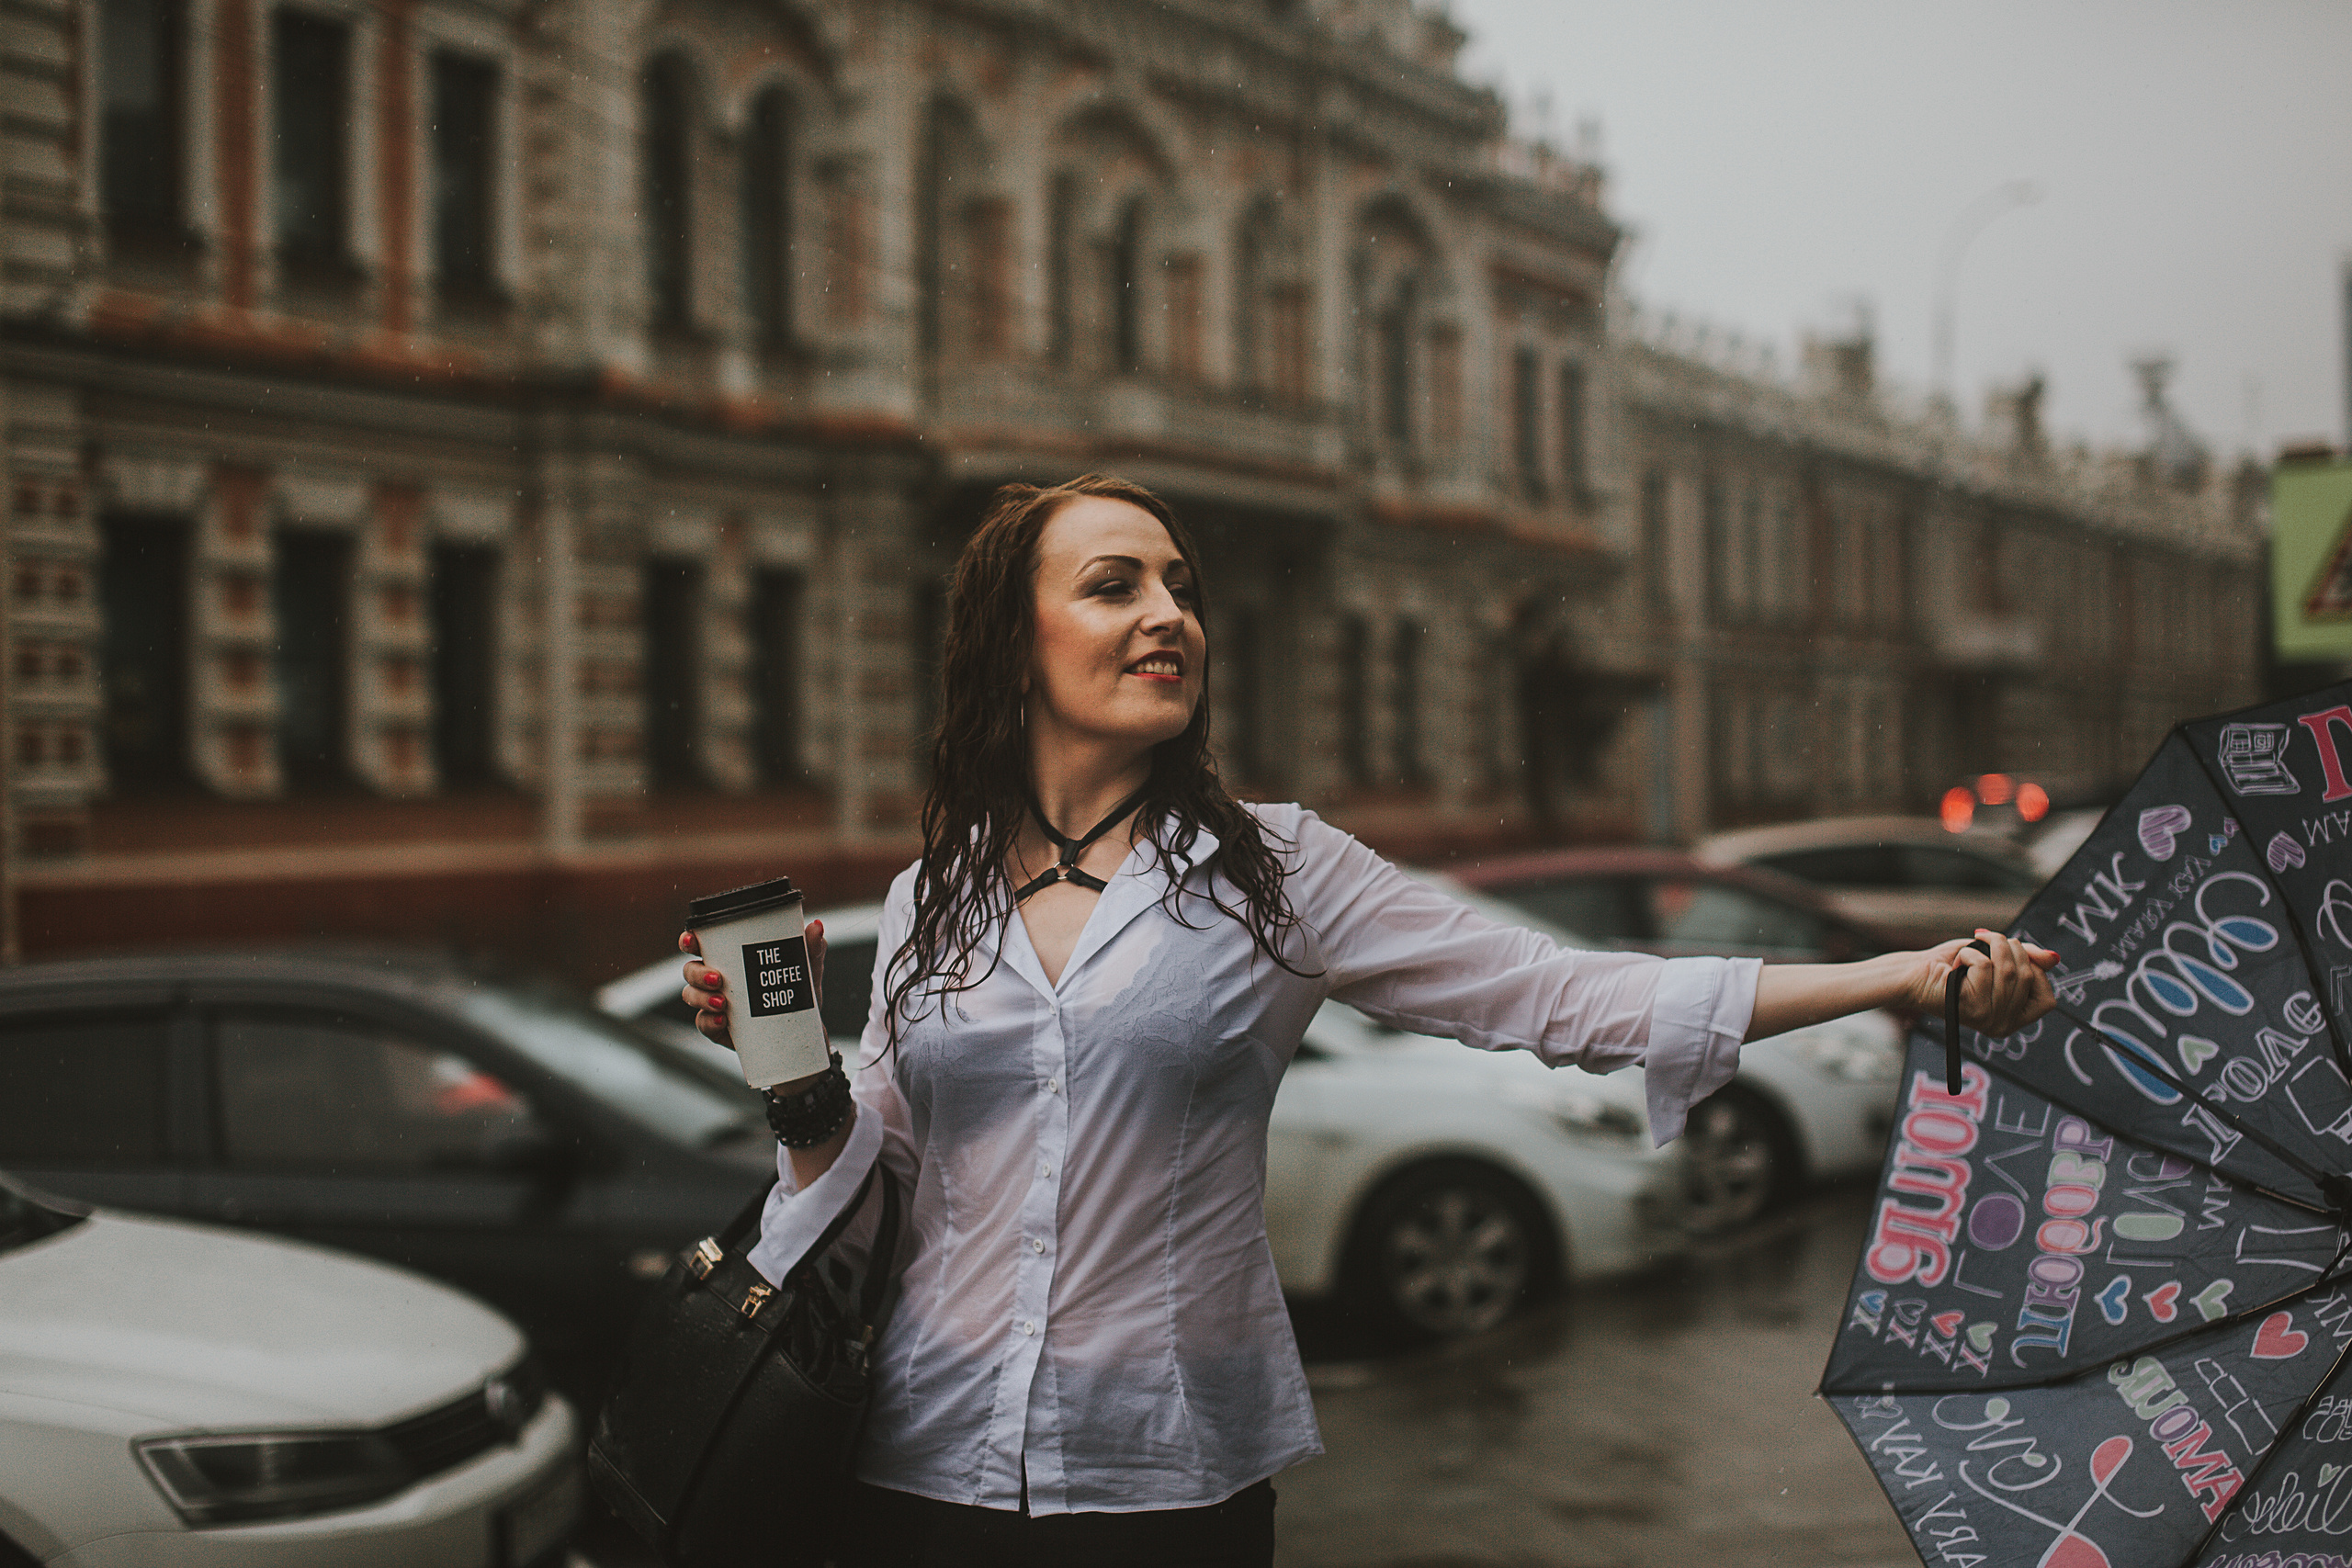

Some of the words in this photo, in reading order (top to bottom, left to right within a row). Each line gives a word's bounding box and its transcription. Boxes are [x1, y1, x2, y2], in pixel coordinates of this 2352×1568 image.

[756, 947, 781, 965] THE
[759, 965, 802, 987] COFFEE
[762, 988, 795, 1009] SHOP
